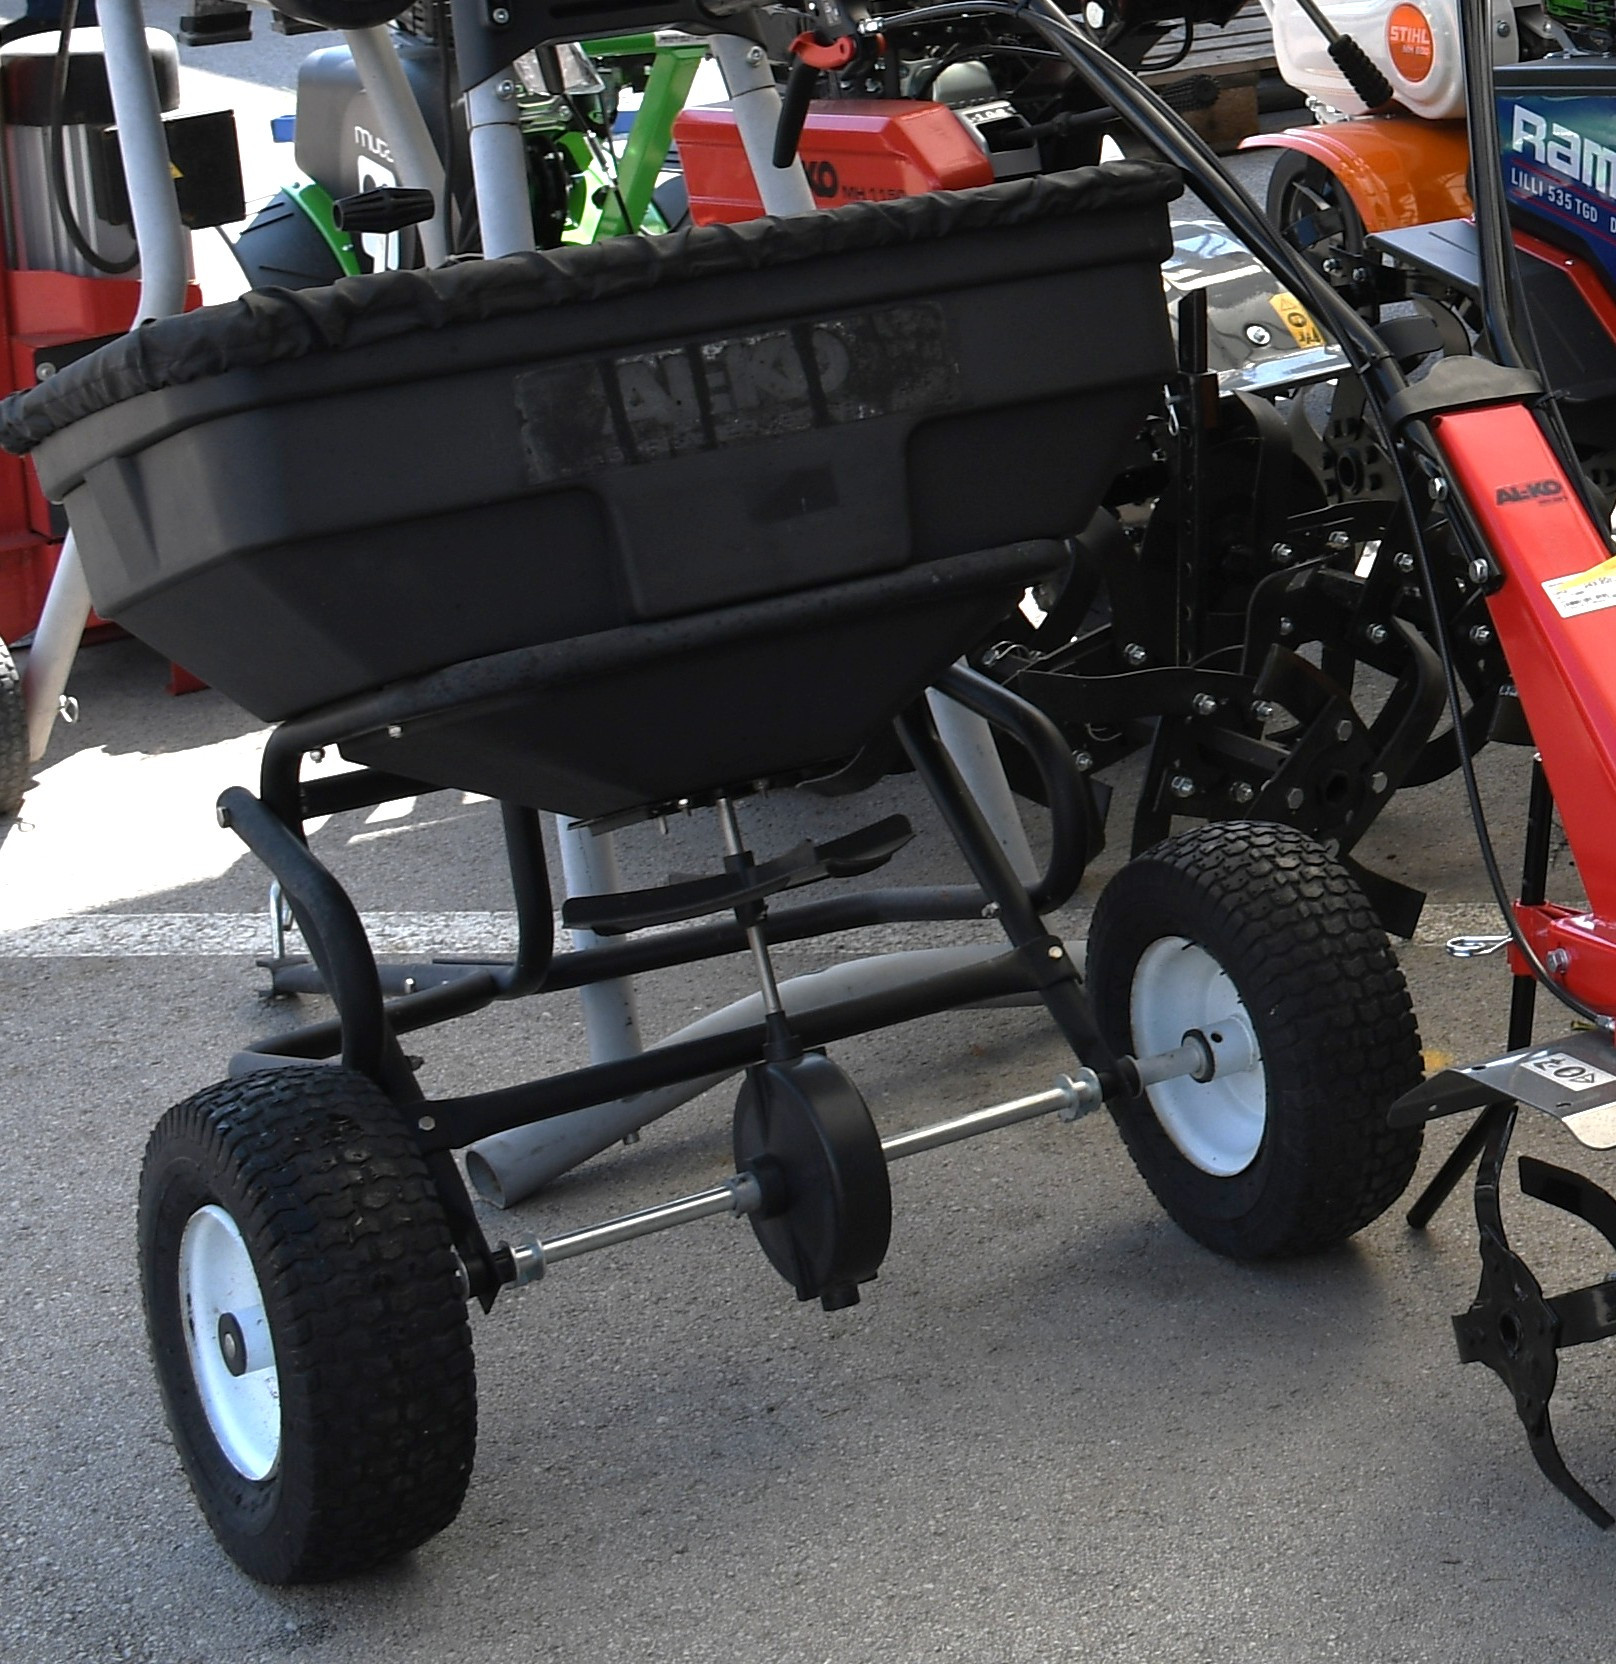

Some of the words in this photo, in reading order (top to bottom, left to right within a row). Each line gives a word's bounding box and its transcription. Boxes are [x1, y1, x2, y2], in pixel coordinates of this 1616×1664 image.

[1390, 25, 1431, 45] STIHL
[1510, 167, 1544, 197] LILLI
[1547, 185, 1573, 211] 535
[1574, 197, 1600, 224] TGD
[1496, 479, 1563, 506] AL-KO
